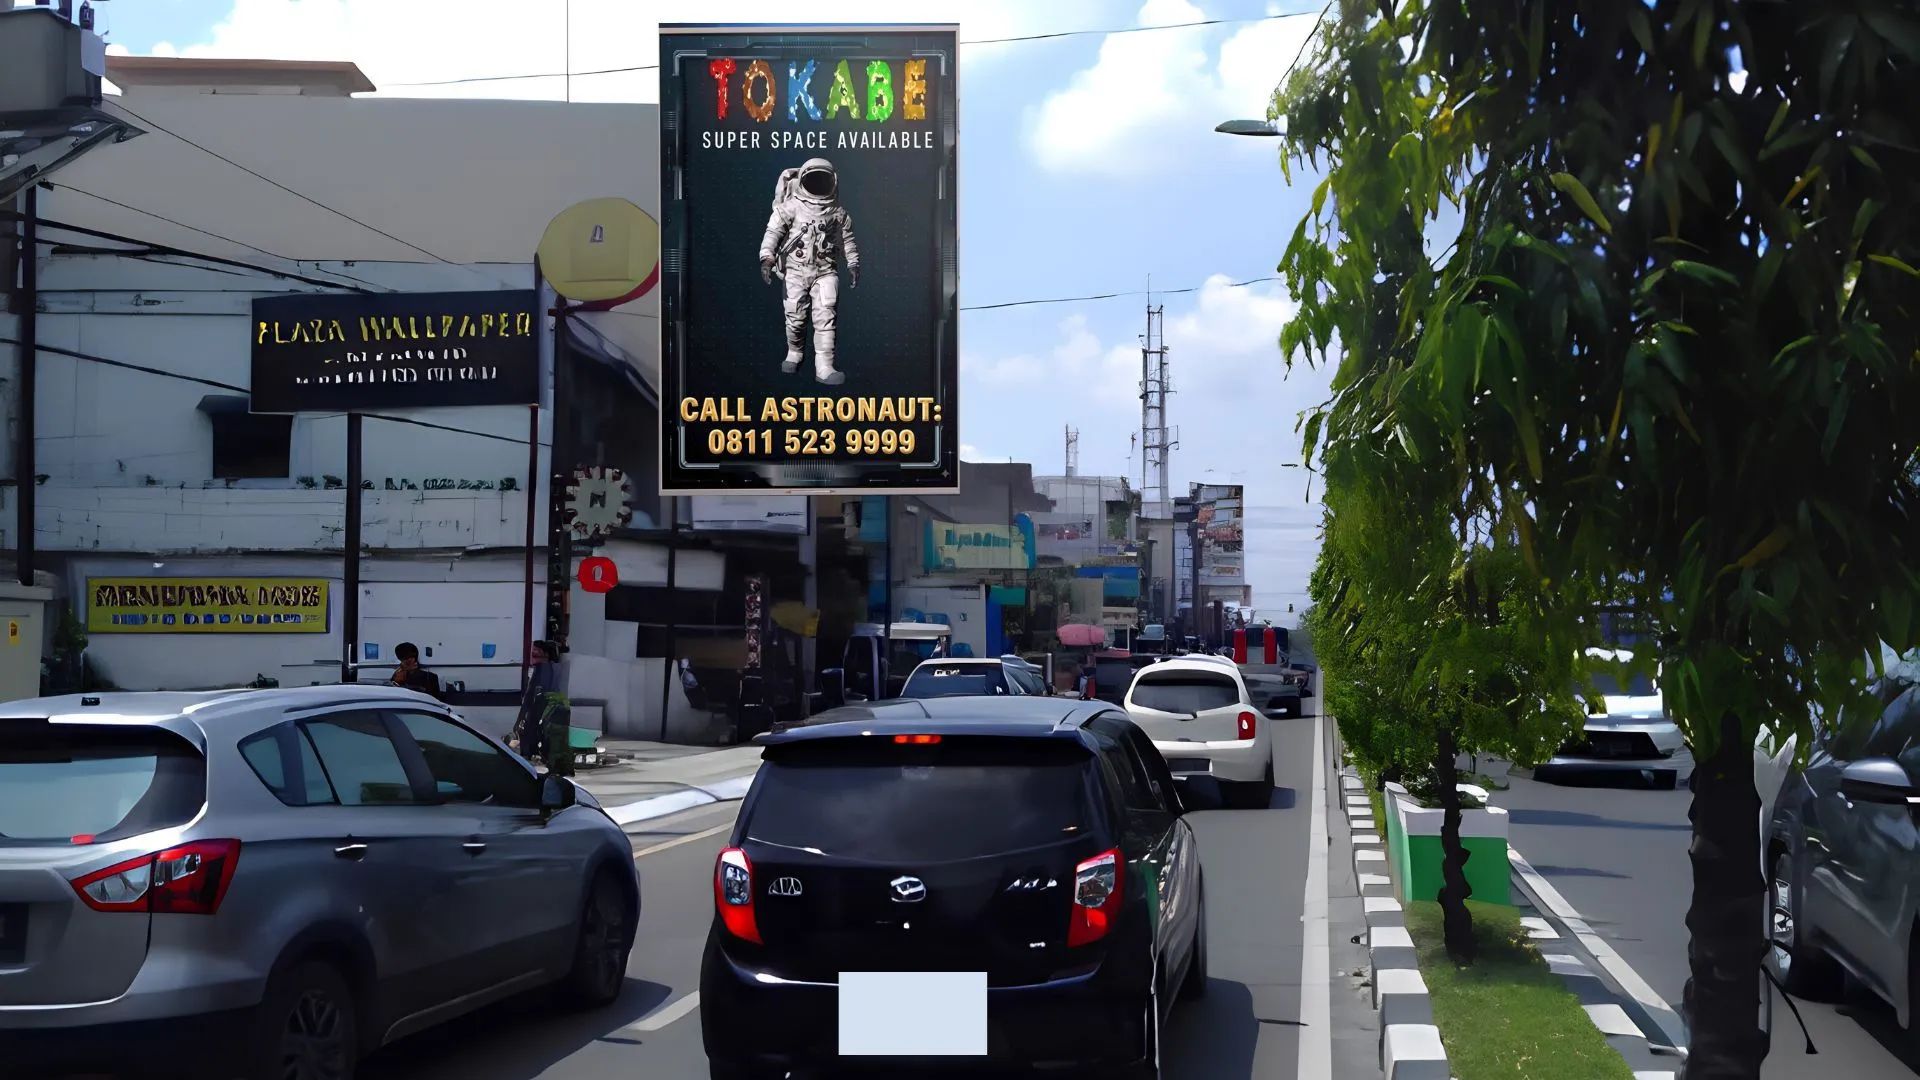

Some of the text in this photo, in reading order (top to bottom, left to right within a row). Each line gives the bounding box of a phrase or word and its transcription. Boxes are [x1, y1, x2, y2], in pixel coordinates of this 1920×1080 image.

[709, 57, 927, 123] TOKABE
[702, 131, 933, 149] SUPER SPACE AVAILABLE
[680, 397, 942, 422] CALL ASTRONAUT:
[708, 429, 915, 455] 0811 523 9999
